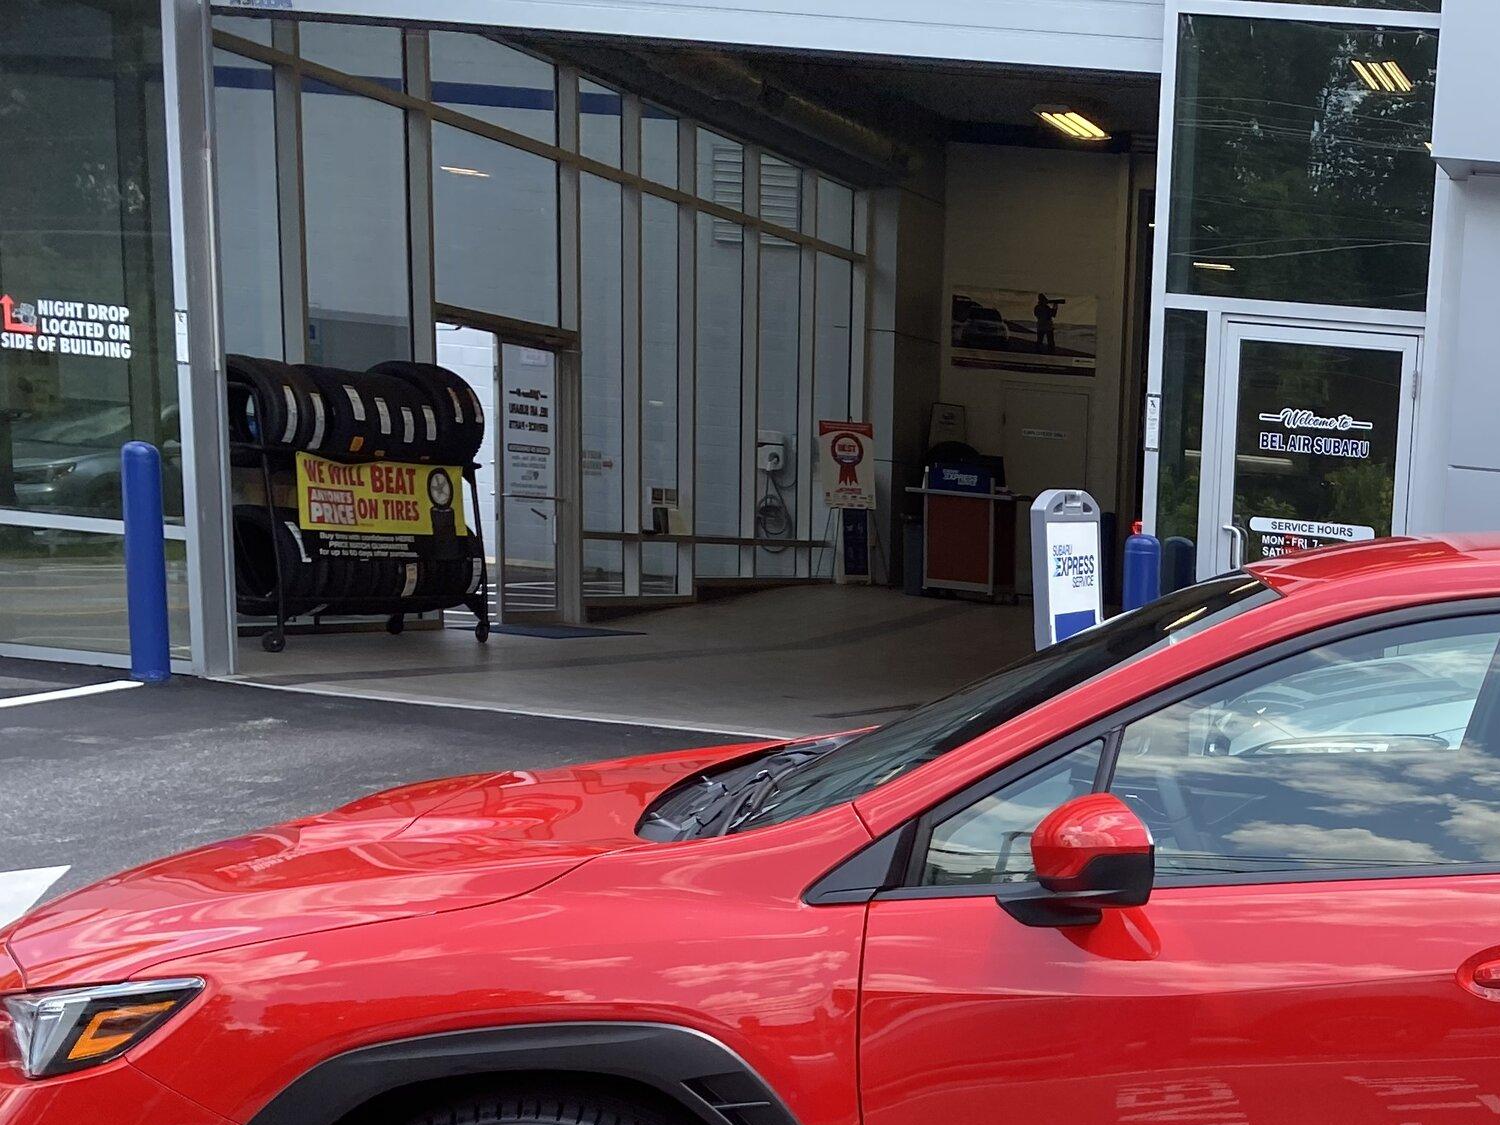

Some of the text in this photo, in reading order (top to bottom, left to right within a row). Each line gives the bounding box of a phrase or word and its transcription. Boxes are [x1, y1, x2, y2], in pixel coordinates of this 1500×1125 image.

[37, 299, 130, 322] NIGHT DROP
[41, 319, 130, 341] LOCATED ON
[1, 332, 131, 359] SIDE OF BUILDING
[1280, 408, 1353, 430] Welcome to
[837, 443, 857, 453] BEST
[1260, 432, 1370, 458] BEL AIR SUBARU
[303, 459, 416, 495] WE WILL BEAT
[311, 501, 356, 525] PRICE
[358, 498, 420, 521] ON TIRES
[1271, 521, 1354, 537] SERVICE HOURS
[1053, 544, 1073, 557] SUBARU
[1052, 555, 1095, 578] EXPRESS
[1072, 575, 1094, 588] SERVICE
